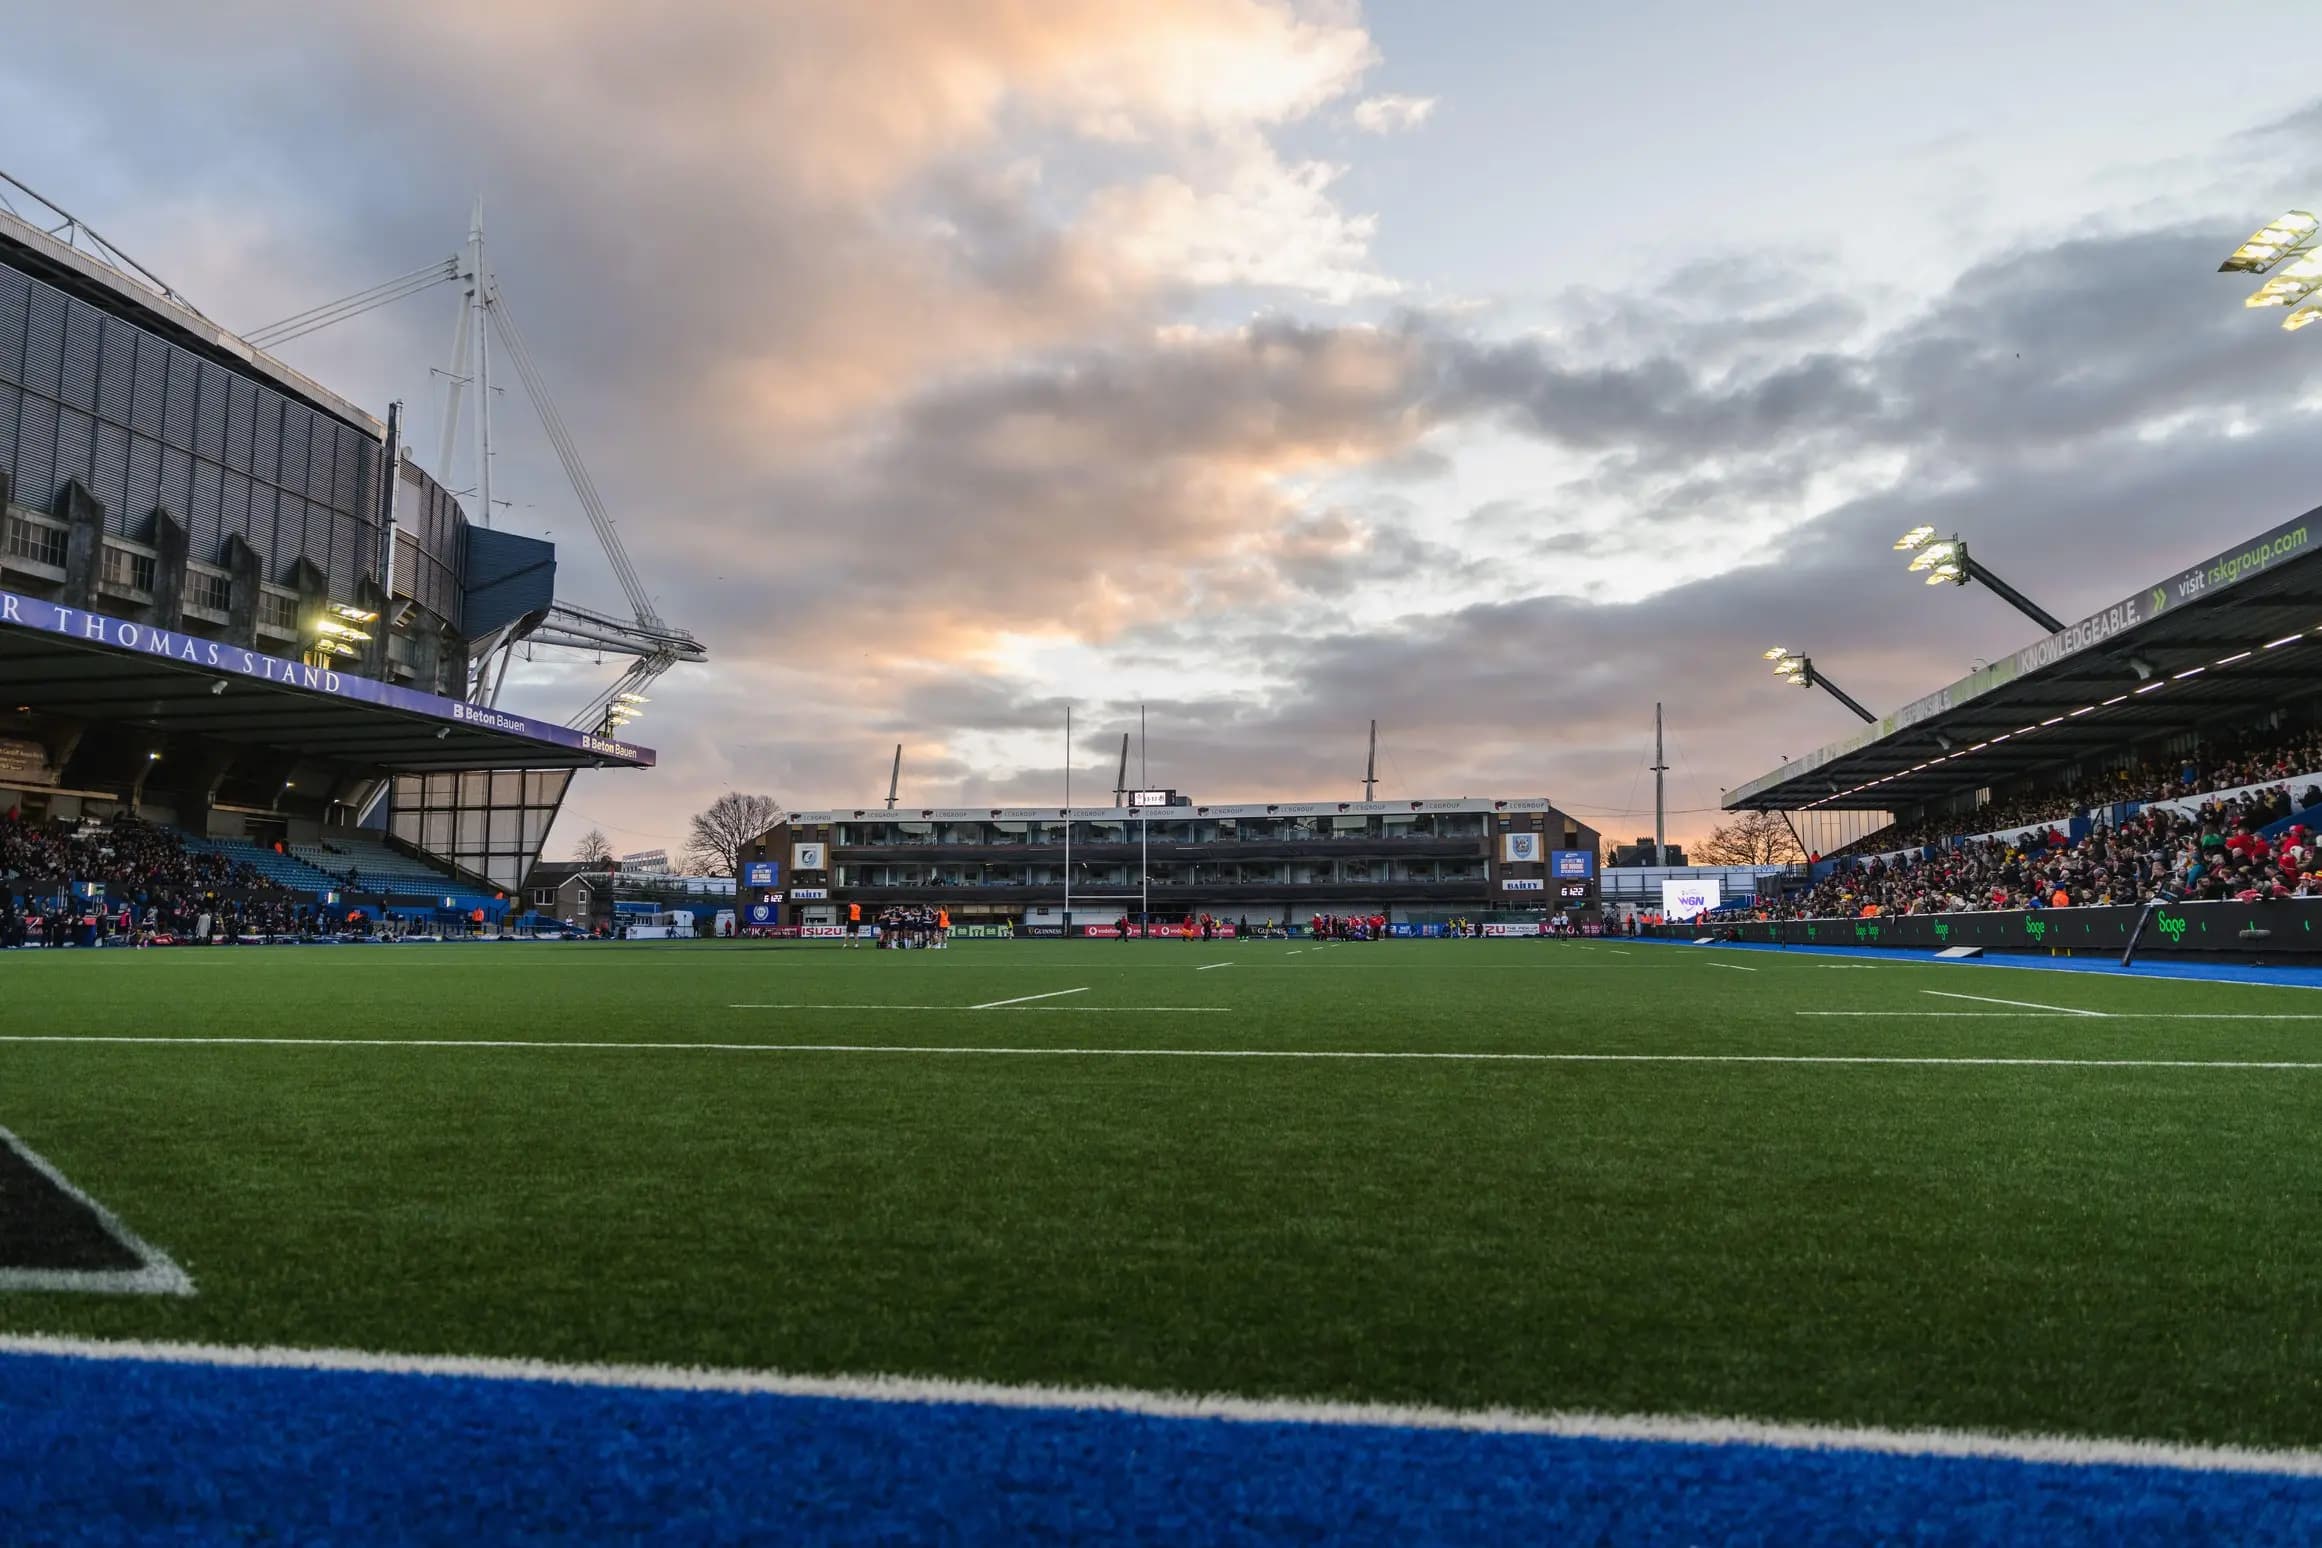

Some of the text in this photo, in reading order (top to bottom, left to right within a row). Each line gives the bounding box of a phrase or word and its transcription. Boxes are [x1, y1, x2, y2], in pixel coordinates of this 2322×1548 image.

[2178, 526, 2308, 597] visit rskgroup.com
[54, 607, 219, 665] THOMAS
[243, 653, 340, 692] STAND
[2021, 600, 2141, 673] KNOWLEDGEABLE.
[466, 709, 496, 725] Beton
[497, 714, 525, 732] Bauen
[592, 739, 615, 753] Beton
[615, 743, 638, 759] Bauen
[802, 927, 842, 936] ISUZU
[1935, 919, 1949, 941] Sage
[2026, 915, 2046, 942] Sage
[2159, 910, 2187, 943] Sage
